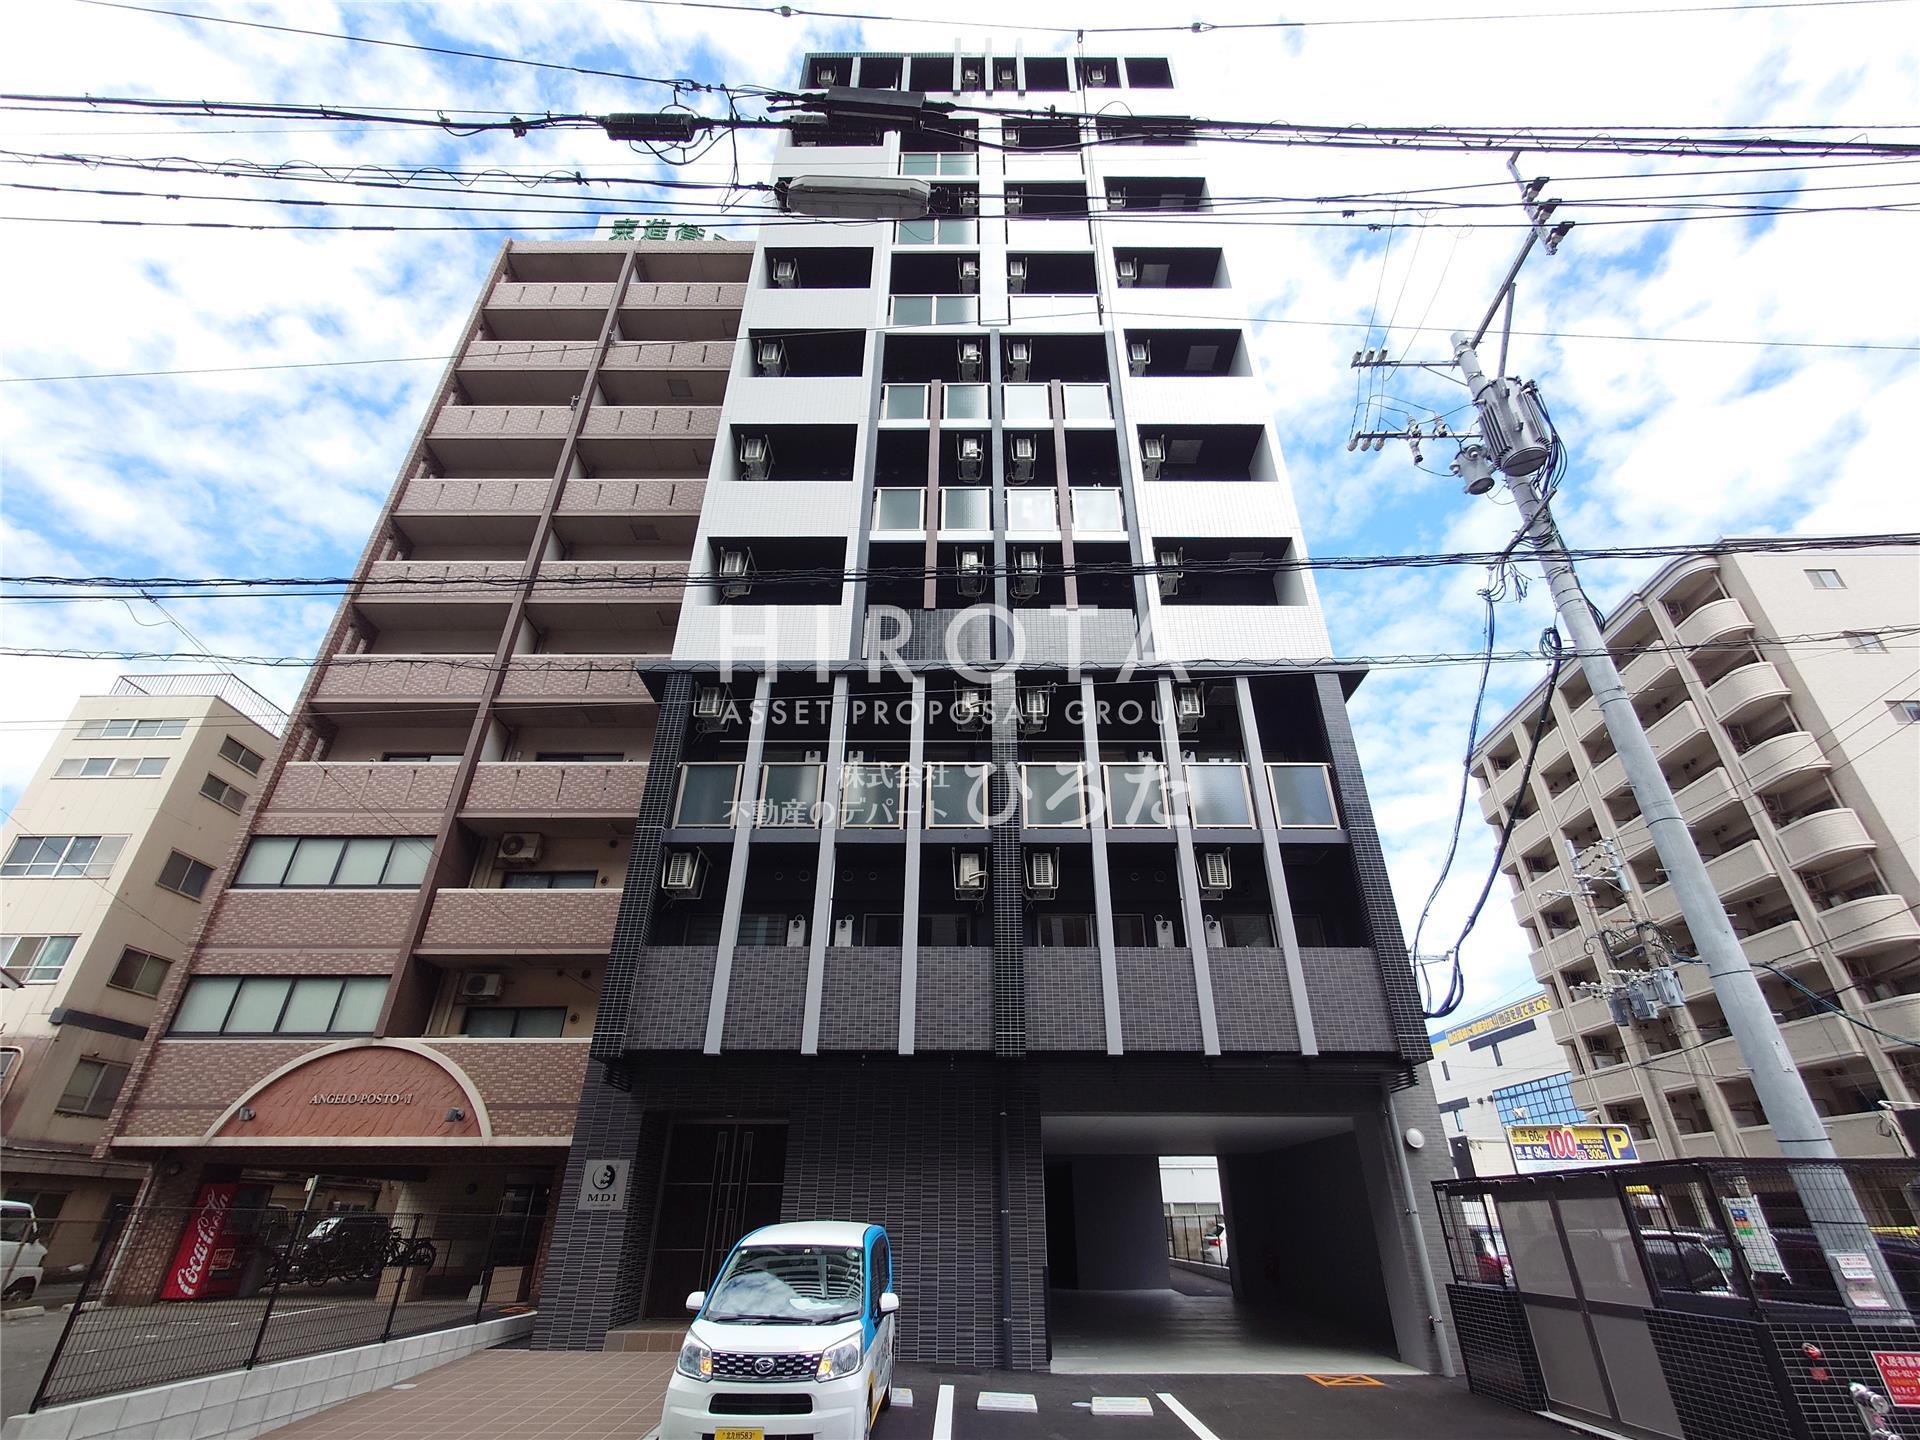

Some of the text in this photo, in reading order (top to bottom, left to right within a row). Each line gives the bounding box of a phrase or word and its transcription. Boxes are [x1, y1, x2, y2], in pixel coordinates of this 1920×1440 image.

[608, 218, 728, 240] 東進衛
[1605, 1127, 1630, 1159] P
[587, 1193, 617, 1202] MDI
